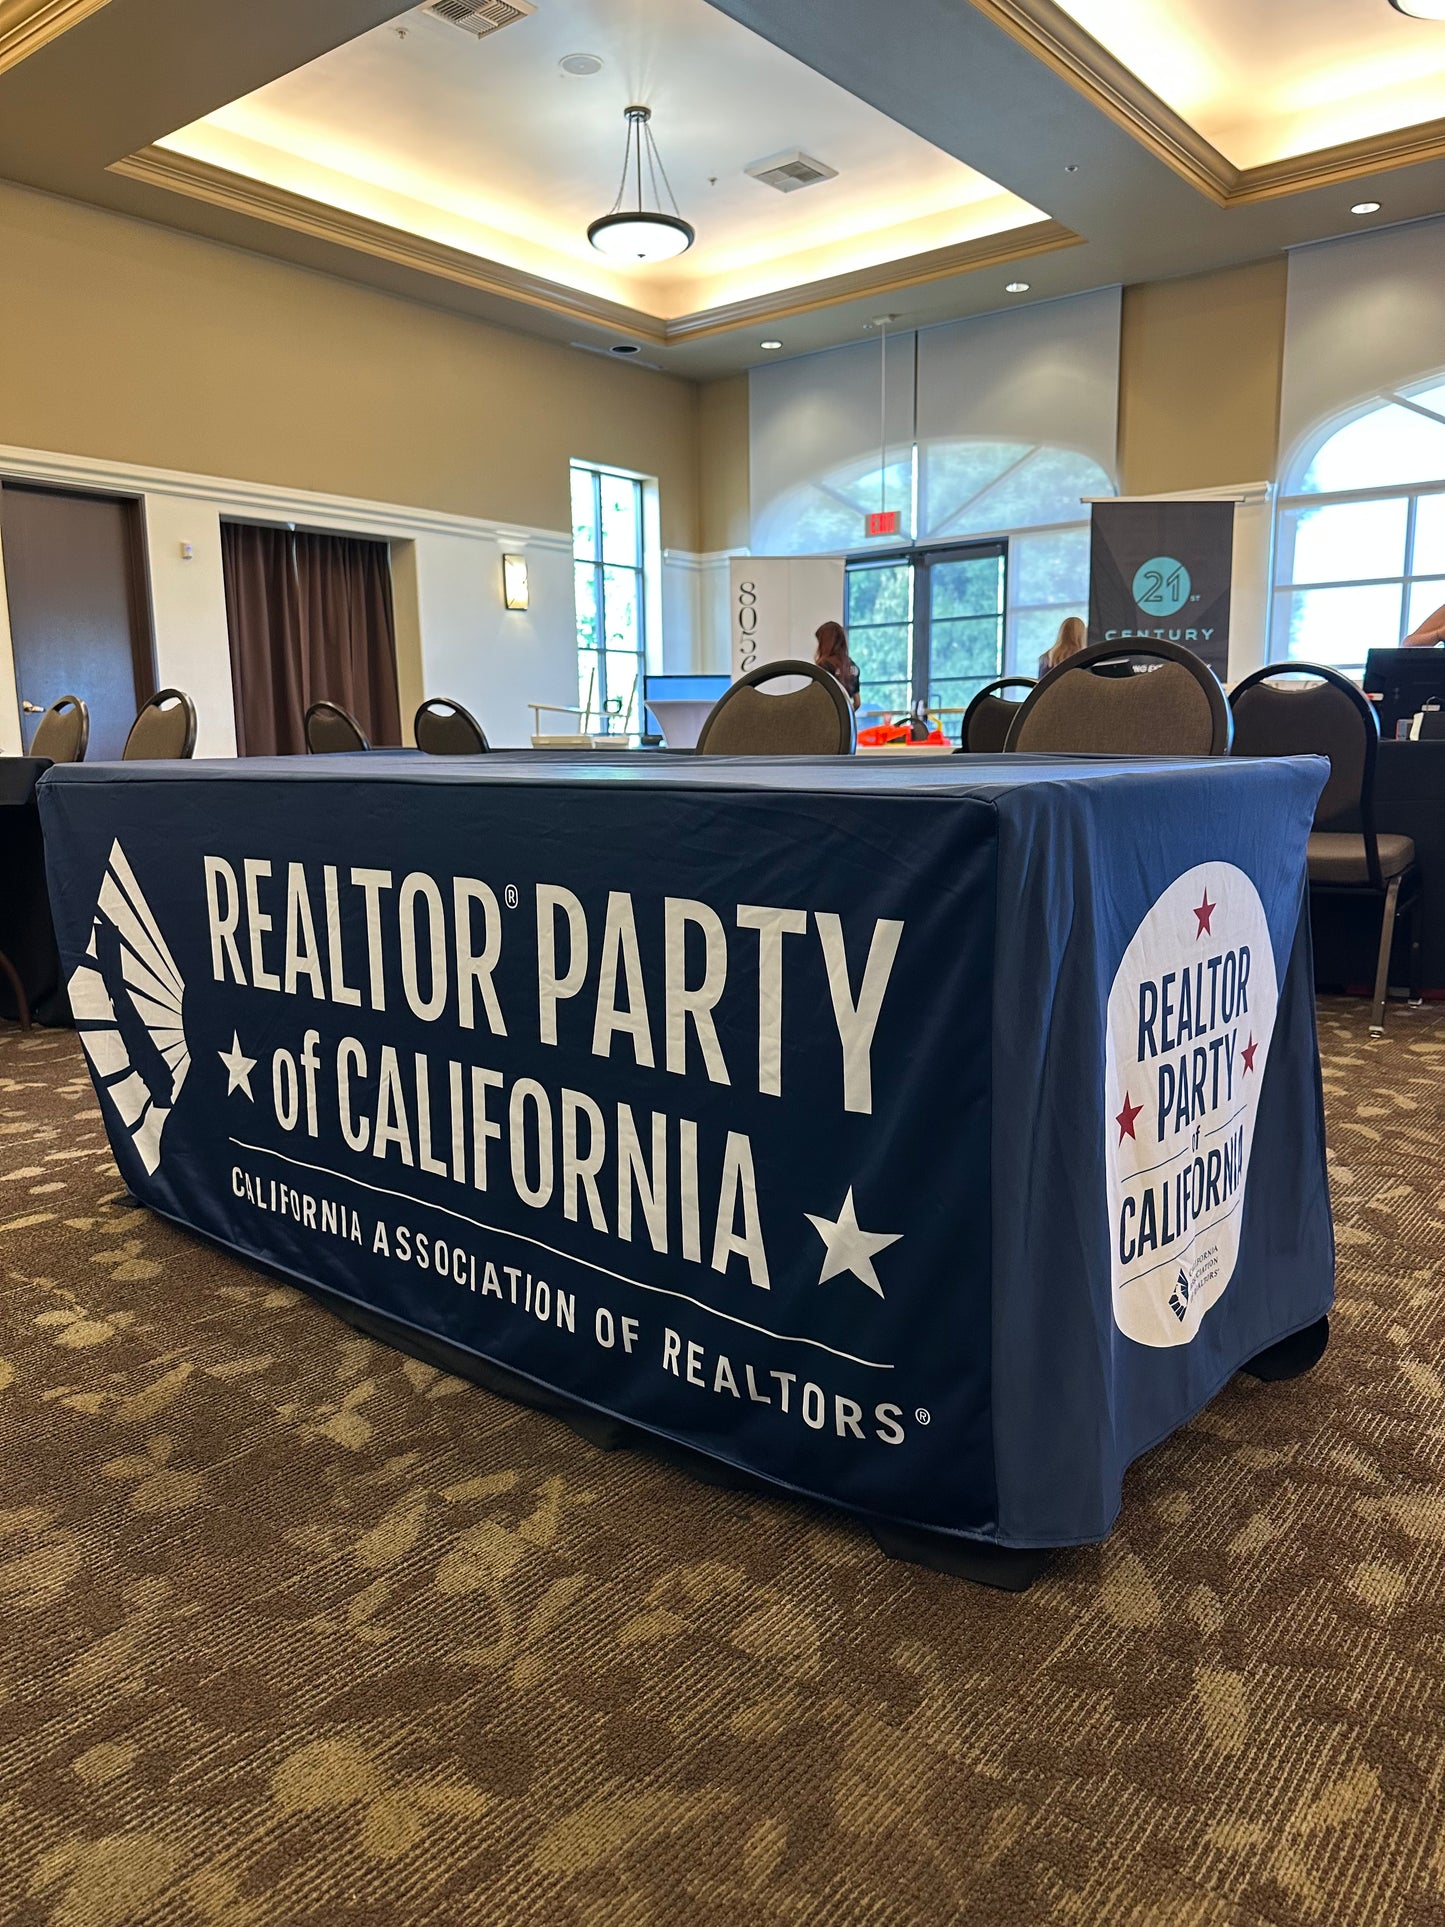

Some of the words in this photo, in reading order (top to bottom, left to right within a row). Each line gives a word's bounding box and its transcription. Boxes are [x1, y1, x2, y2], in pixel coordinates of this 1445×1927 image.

[869, 512, 896, 535] EXIT
[1104, 628, 1214, 641] CENTURY
[1142, 568, 1182, 602] 21
[536, 884, 905, 1115] PARTY
[1138, 946, 1251, 1063] REALTOR
[1158, 1029, 1238, 1143] PARTY
[1192, 1125, 1201, 1153] of
[273, 1030, 320, 1138] of
[337, 1037, 771, 1291] CALIFORNIA
[1120, 1125, 1243, 1265] CALIFORNIA
[232, 1167, 363, 1245] CALIFORNIA
[373, 1221, 576, 1334] ASSOCIATION
[596, 1308, 640, 1353] OF
